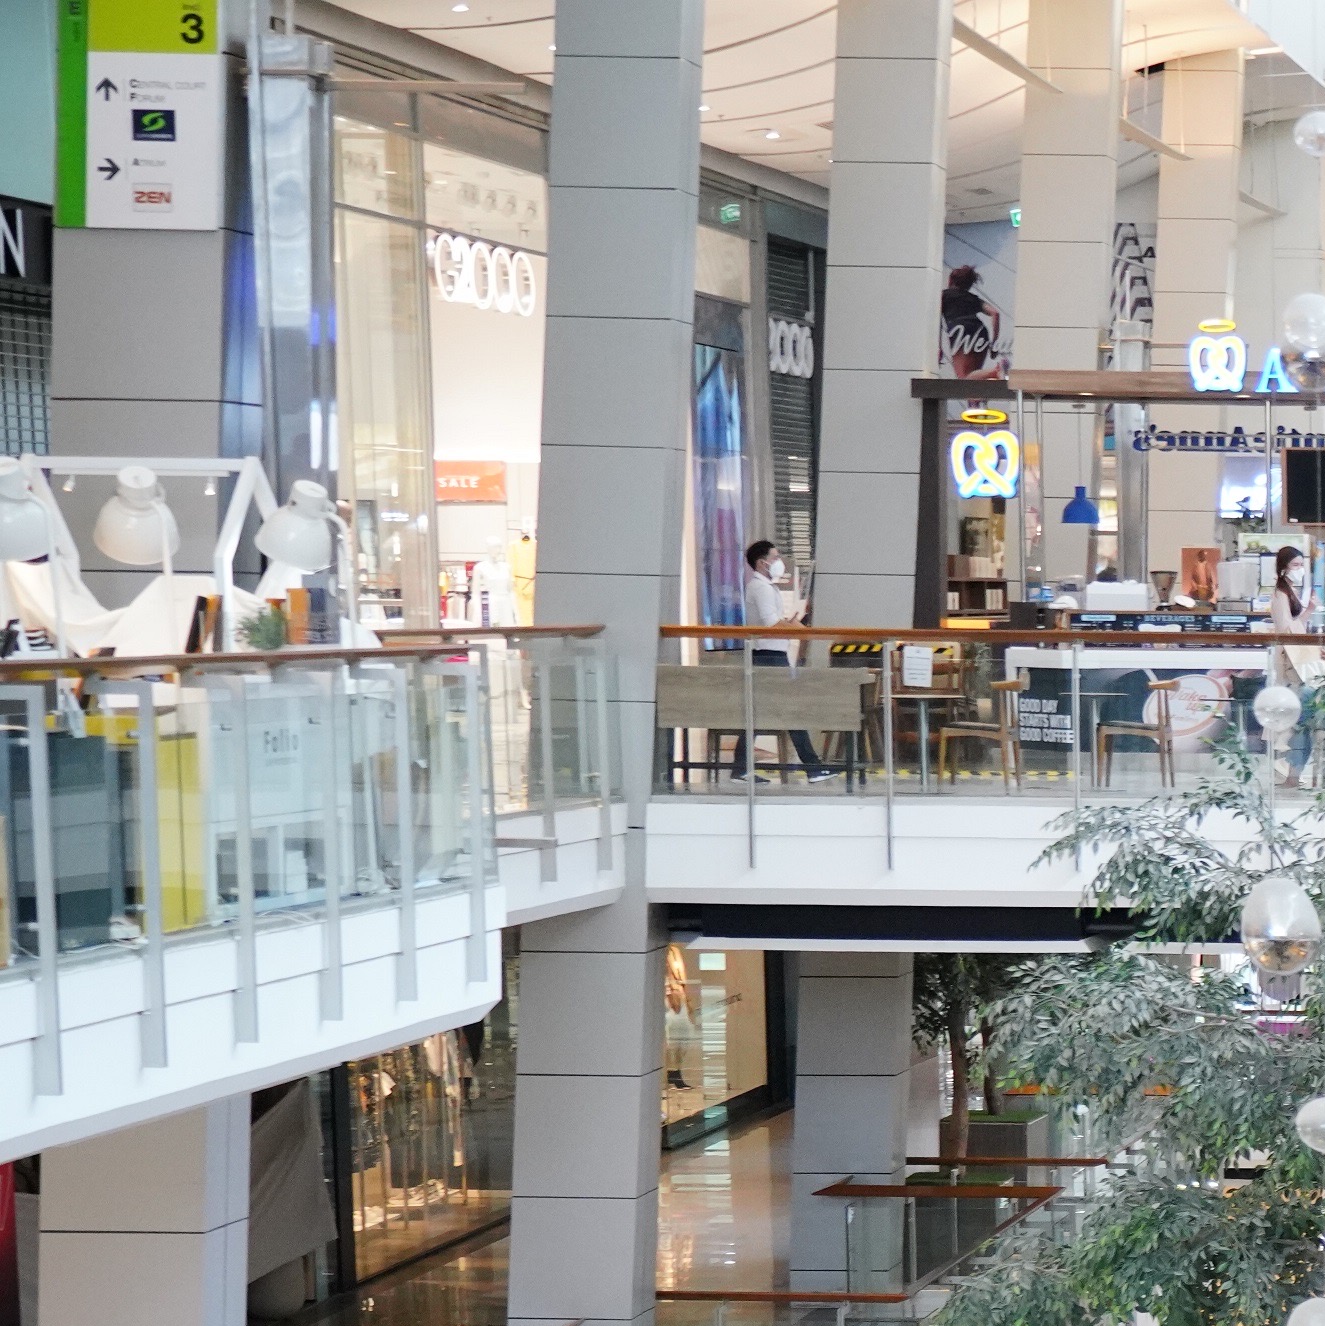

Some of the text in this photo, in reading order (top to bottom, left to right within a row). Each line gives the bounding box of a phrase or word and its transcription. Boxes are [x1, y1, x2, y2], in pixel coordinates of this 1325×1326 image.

[181, 13, 204, 44] 3
[133, 191, 172, 203] ZEN
[434, 233, 536, 317] G2000
[438, 477, 480, 488] SALE
